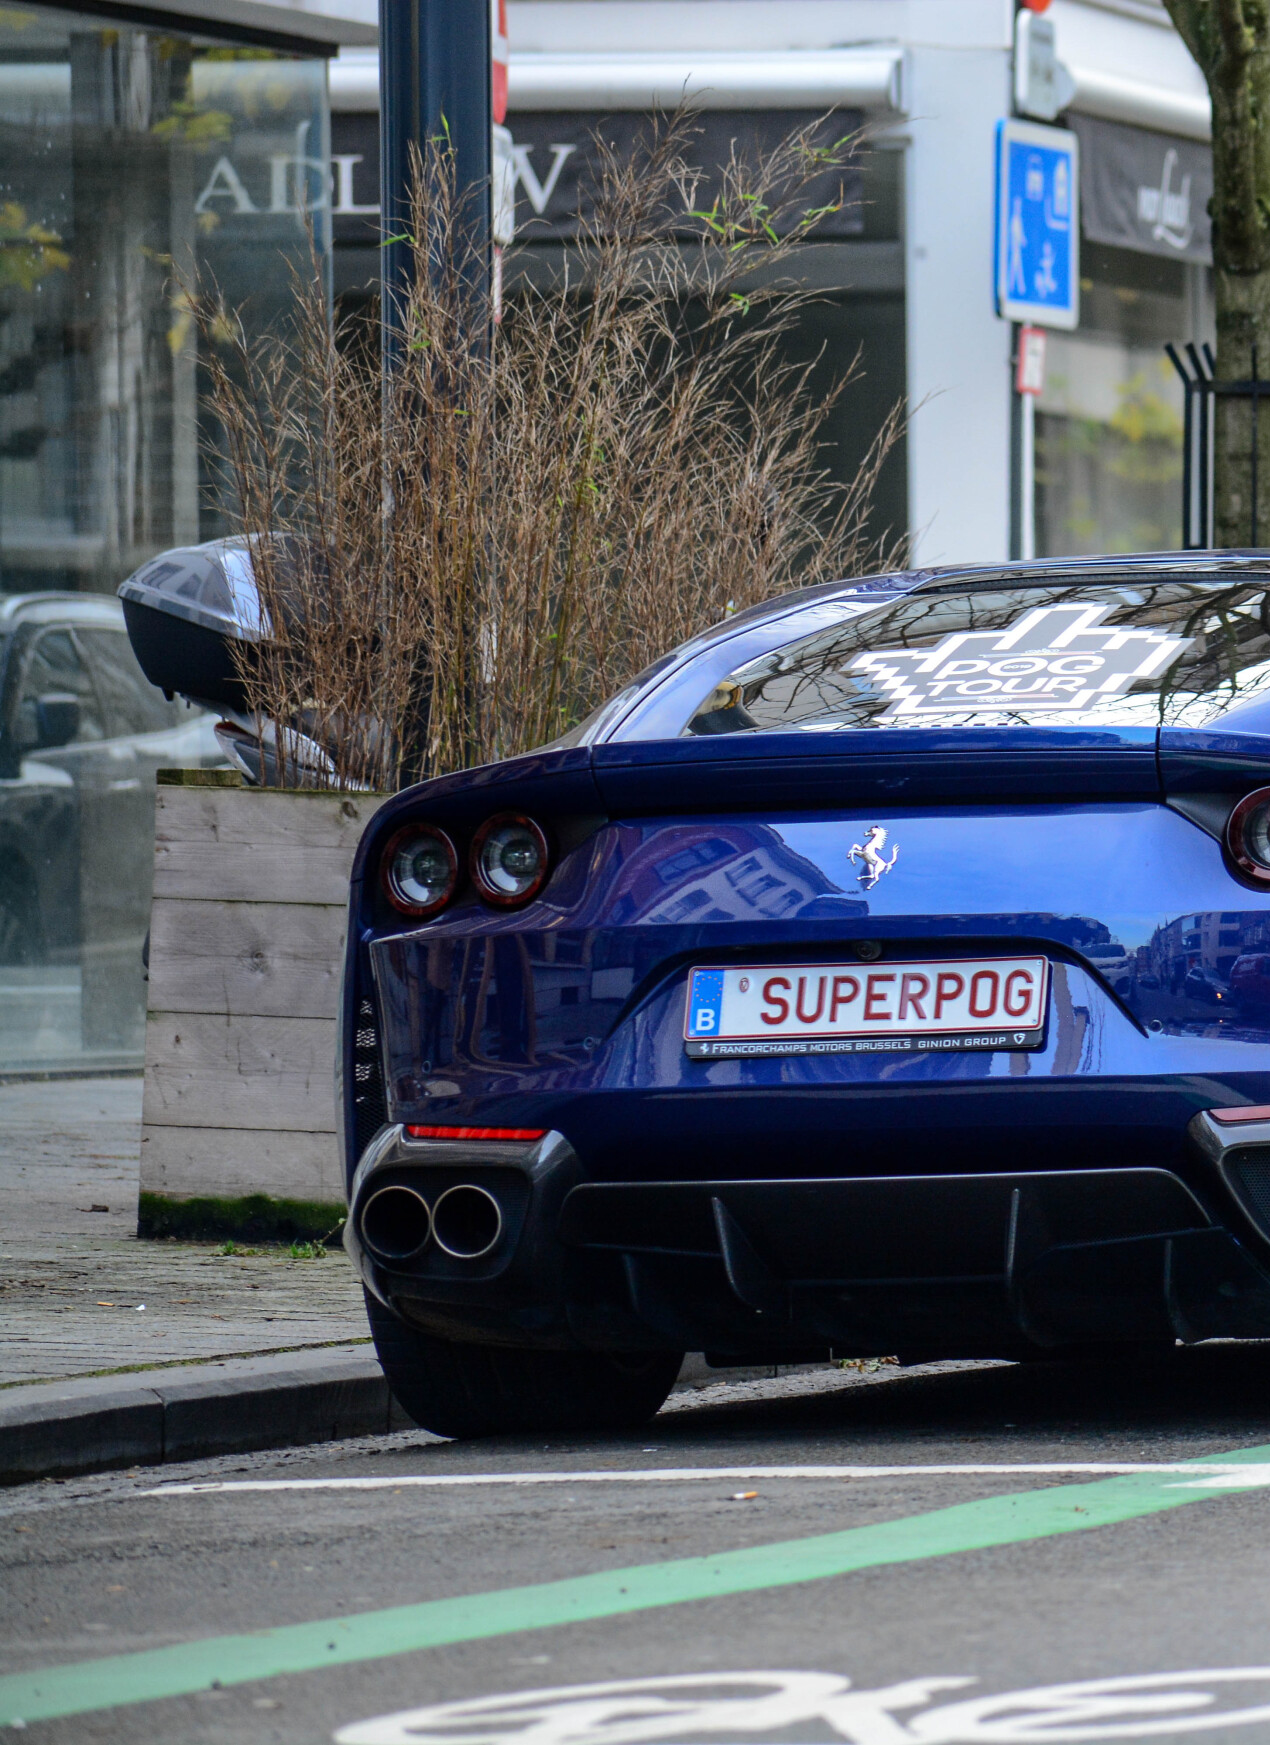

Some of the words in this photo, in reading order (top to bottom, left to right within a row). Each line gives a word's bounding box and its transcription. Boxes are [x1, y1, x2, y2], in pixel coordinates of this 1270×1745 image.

[933, 655, 1106, 680] POG
[926, 676, 1088, 697] TOUR
[695, 1008, 716, 1031] B
[760, 968, 1035, 1025] SUPERPOG
[712, 1043, 807, 1054] FRANCORCHAMPS
[810, 1042, 852, 1051] MOTORS
[855, 1041, 911, 1050] BRUSSELS
[917, 1039, 960, 1048] GINION
[964, 1036, 1006, 1046] GROUP
